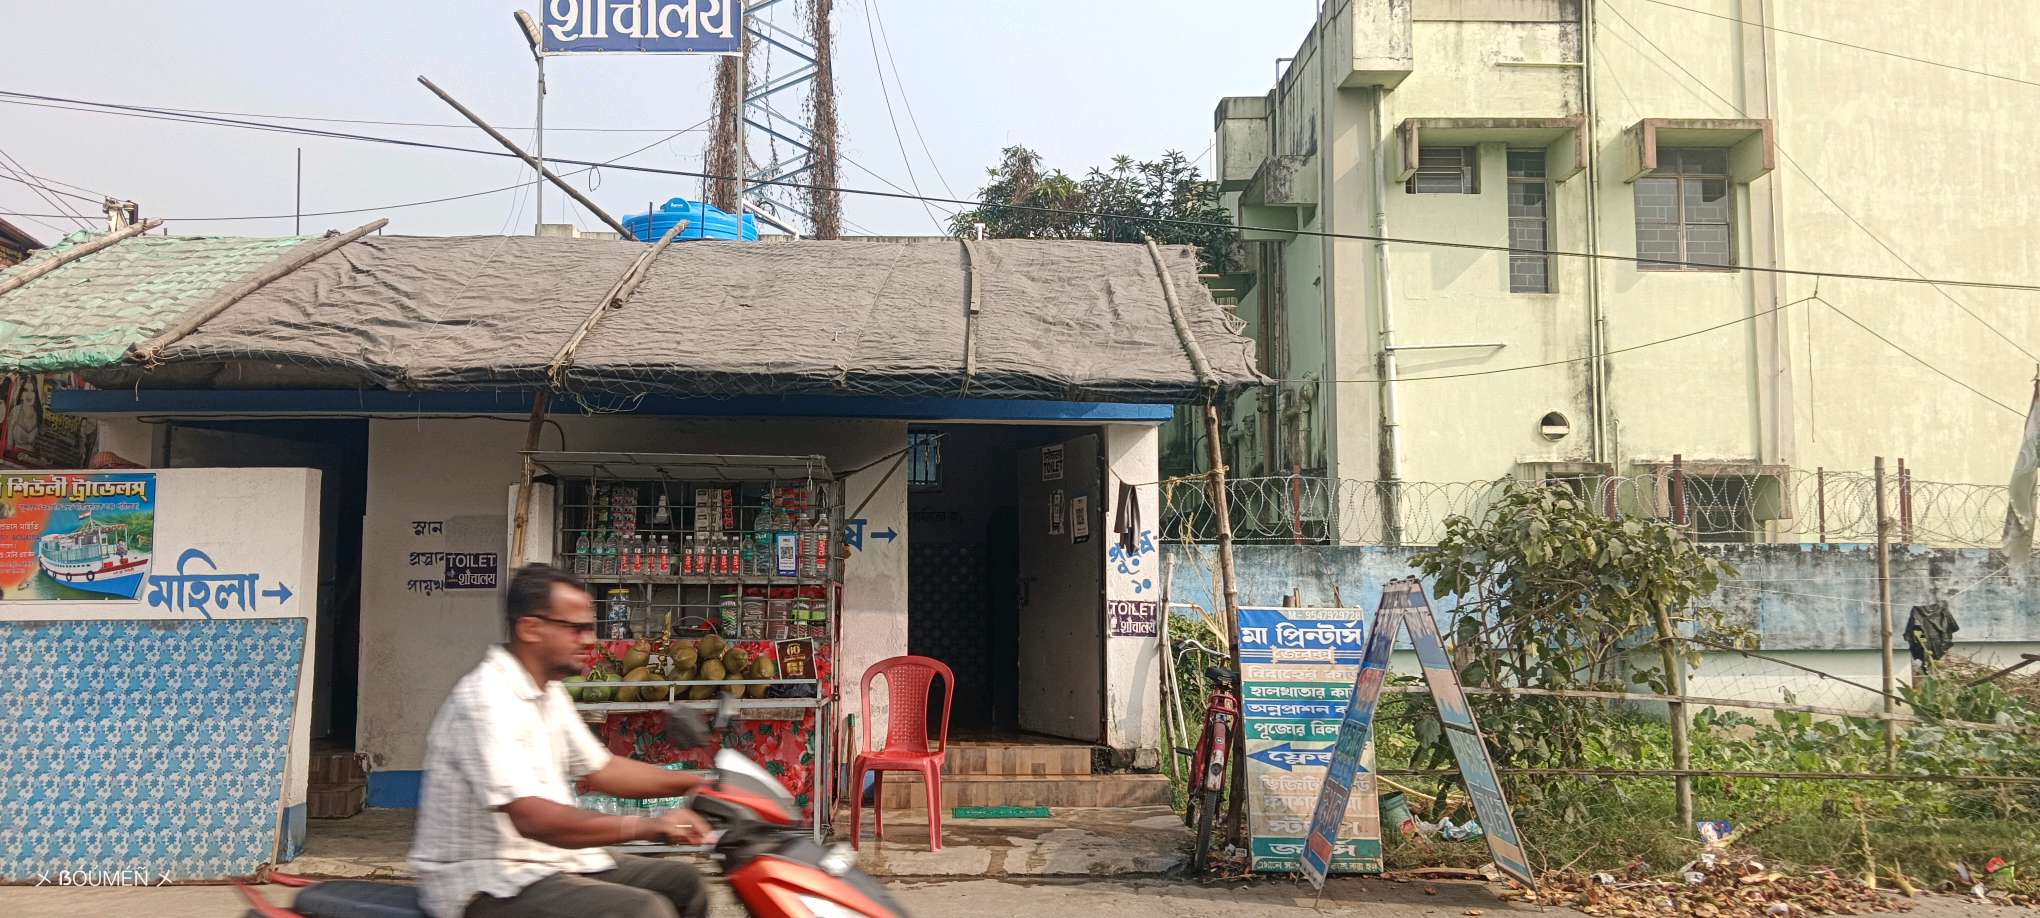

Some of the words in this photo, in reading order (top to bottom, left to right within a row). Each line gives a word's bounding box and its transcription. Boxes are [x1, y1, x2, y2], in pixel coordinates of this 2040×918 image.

[7, 475, 67, 498] শিউলী
[447, 554, 497, 568] TOILET
[148, 548, 260, 619] মহিলা
[407, 578, 444, 596] পায়খ
[1110, 601, 1157, 616] TOILET
[1240, 626, 1268, 645] মা
[1275, 620, 1362, 648] প্রিন্টার্স
[1249, 686, 1325, 700] হালখাতার
[1246, 703, 1330, 716] অন্নপ্রাশন
[1254, 722, 1307, 741] পূজোর
